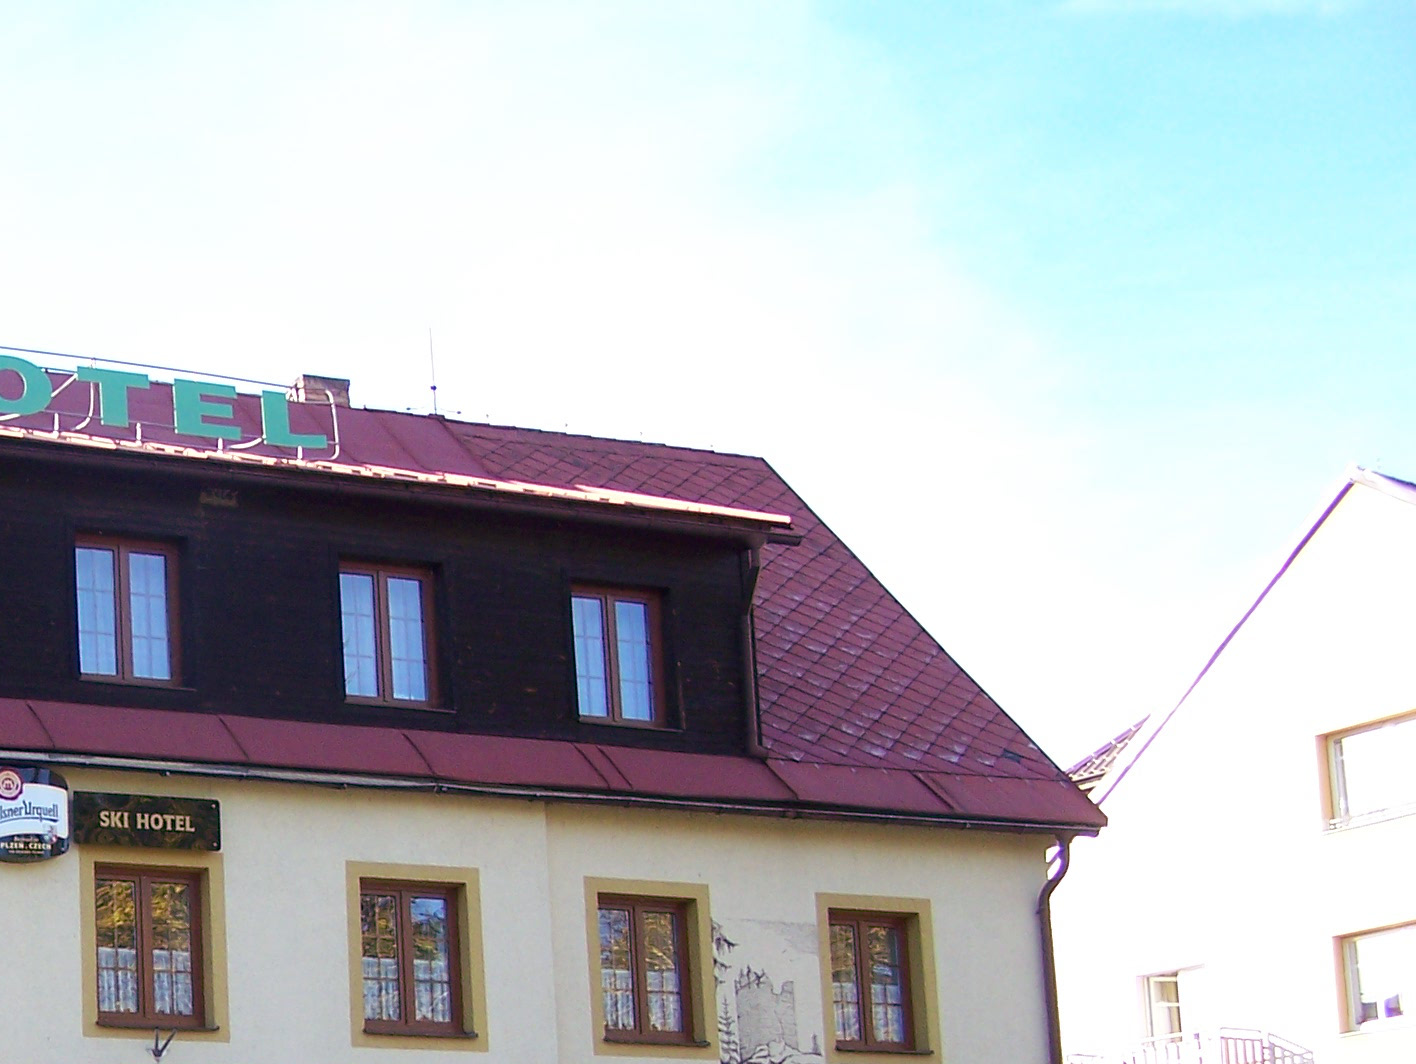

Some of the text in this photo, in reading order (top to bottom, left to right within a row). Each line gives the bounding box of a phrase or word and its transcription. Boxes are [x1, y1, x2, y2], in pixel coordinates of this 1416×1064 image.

[23, 800, 59, 823] Urquell
[99, 811, 196, 833] SKI HOTEL
